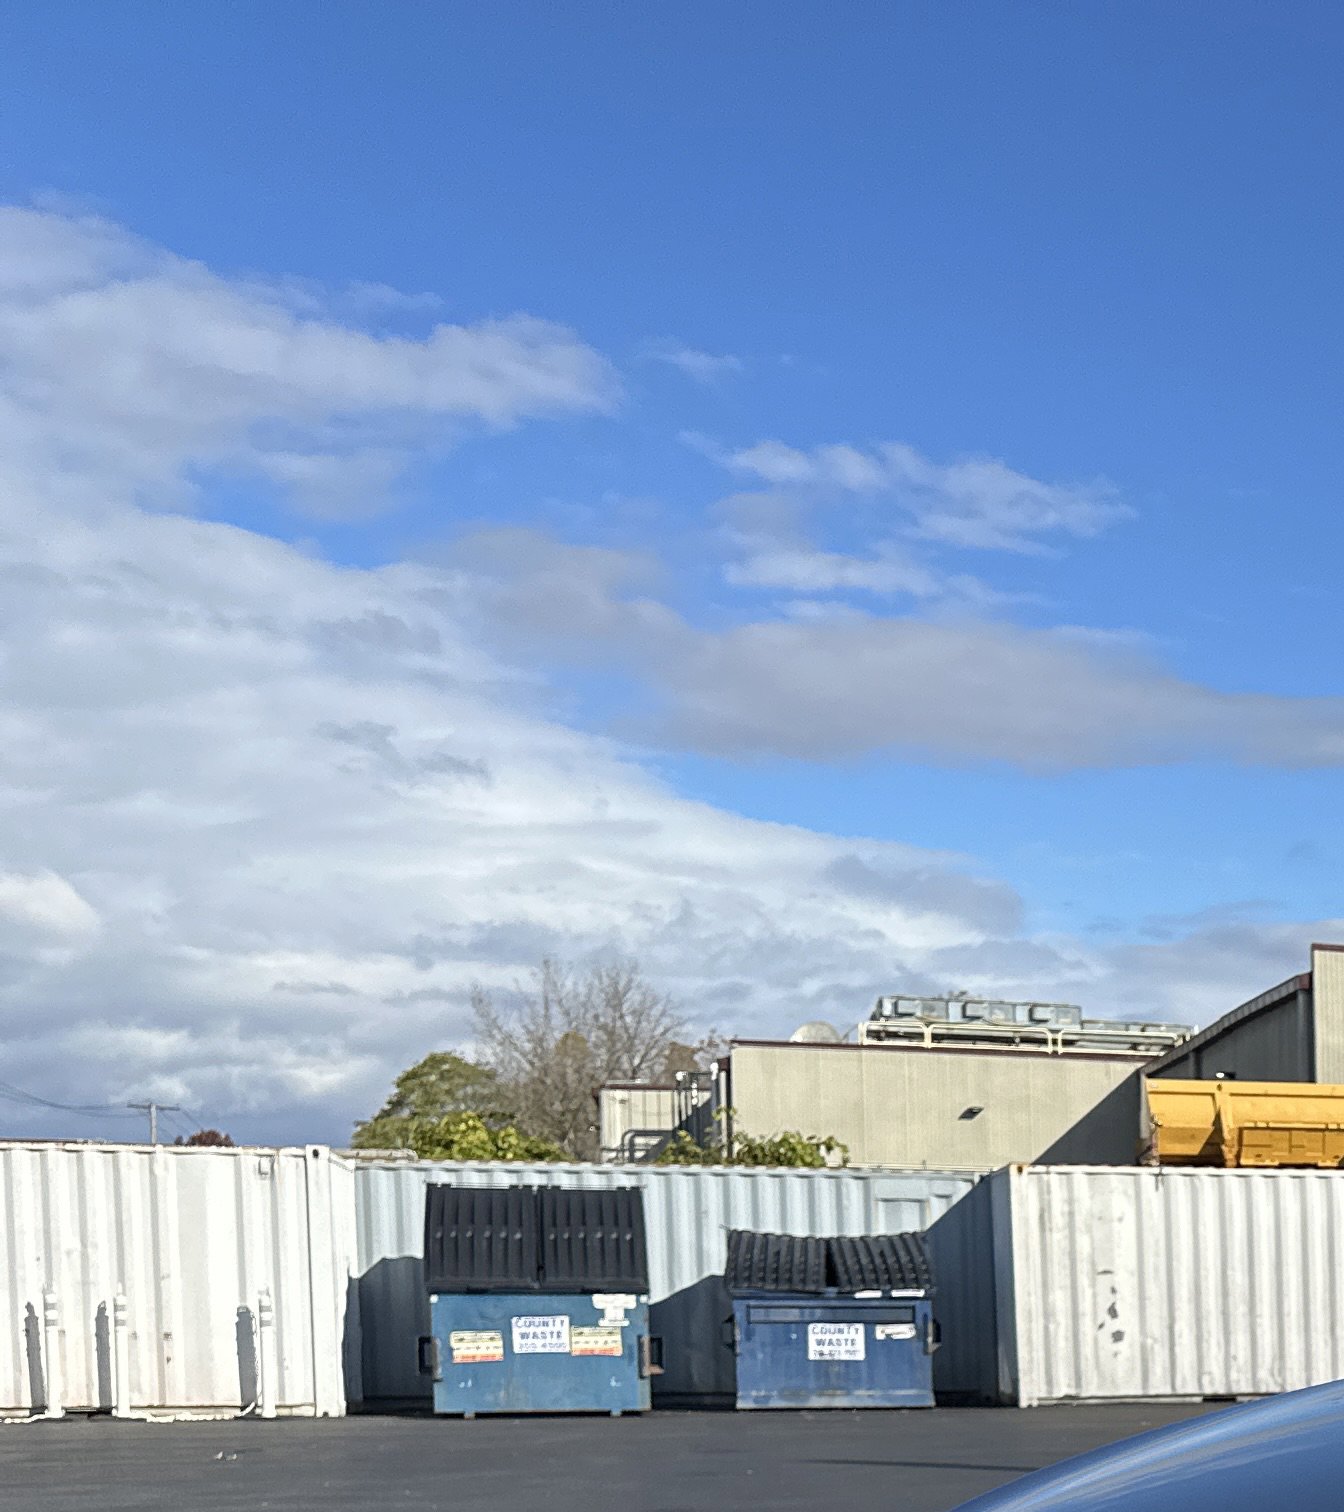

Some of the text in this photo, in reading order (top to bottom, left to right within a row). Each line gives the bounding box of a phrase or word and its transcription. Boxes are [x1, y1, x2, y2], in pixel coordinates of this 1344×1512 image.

[515, 1318, 565, 1328] COUNTY
[519, 1331, 562, 1340] WASTE
[812, 1327, 860, 1335] COUNTY
